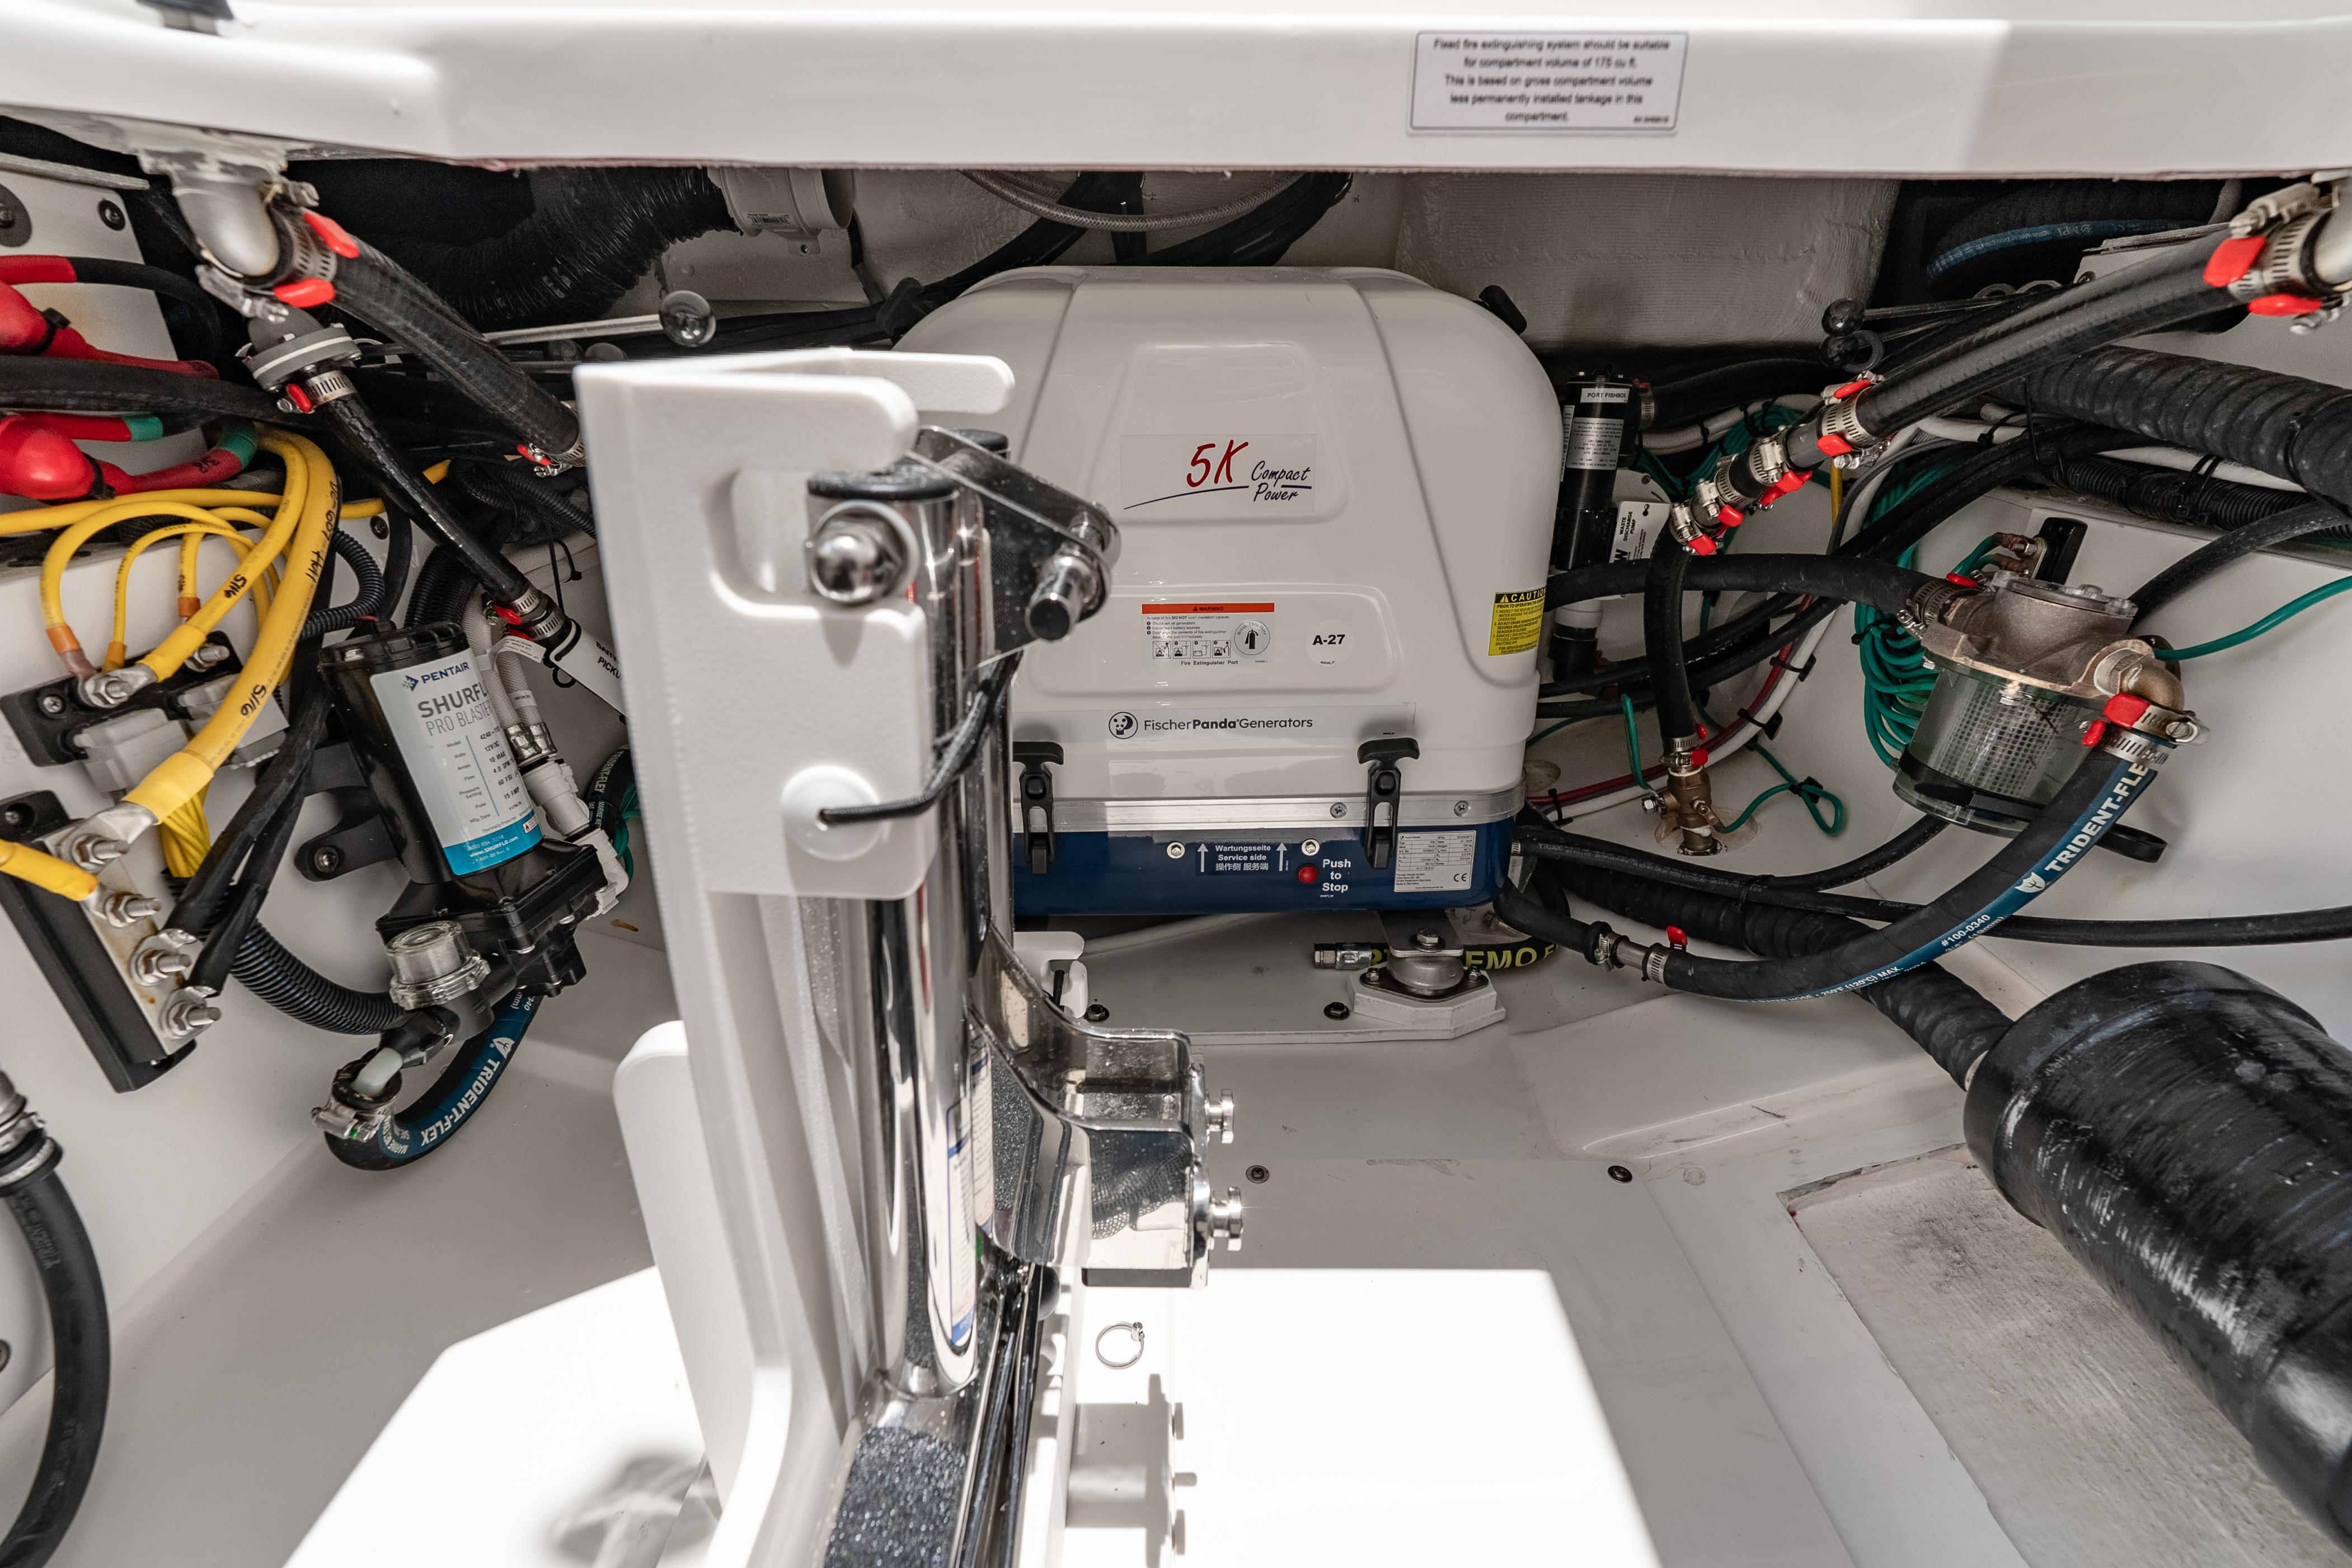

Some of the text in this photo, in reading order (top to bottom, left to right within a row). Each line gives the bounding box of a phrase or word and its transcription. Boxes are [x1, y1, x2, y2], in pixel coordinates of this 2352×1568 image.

[1434, 39, 1670, 52] Fixed fire extinguishing system should be suitable
[1464, 55, 1477, 67] for
[1479, 58, 1542, 69] compartment
[1546, 58, 1579, 68] volume
[1582, 57, 1592, 68] of
[1614, 58, 1626, 68] cu
[1445, 73, 1653, 88] This is based on gross compartment volume
[1450, 93, 1643, 106] less permanently installed tankage in this
[1505, 111, 1569, 123] compartment.
[1186, 439, 1248, 488] 5K
[1251, 460, 1311, 487] Compact
[1254, 482, 1299, 502] Power
[1623, 511, 1633, 541] DISCHARGE
[1511, 588, 1545, 602] CAUTIO
[1237, 625, 1247, 636] Break
[1312, 634, 1345, 645] A-27
[421, 662, 469, 684] PENTAIR
[598, 656, 622, 680] PICKU
[417, 682, 488, 718] SHURFL
[425, 716, 454, 736] PRO
[459, 786, 480, 796] Pressure
[466, 791, 482, 800] Setting
[2044, 762, 2149, 872] TRIDENT-FLE
[481, 824, 501, 833] Thermally
[1322, 859, 1351, 868] Push
[1330, 871, 1342, 880] to
[1322, 882, 1349, 893] Stop
[1941, 914, 1991, 947] #100-0340
[1844, 974, 1878, 990] (120°C)
[1877, 965, 1904, 980] MAX.
[420, 1058, 500, 1147] TRIDENT-FLEX
